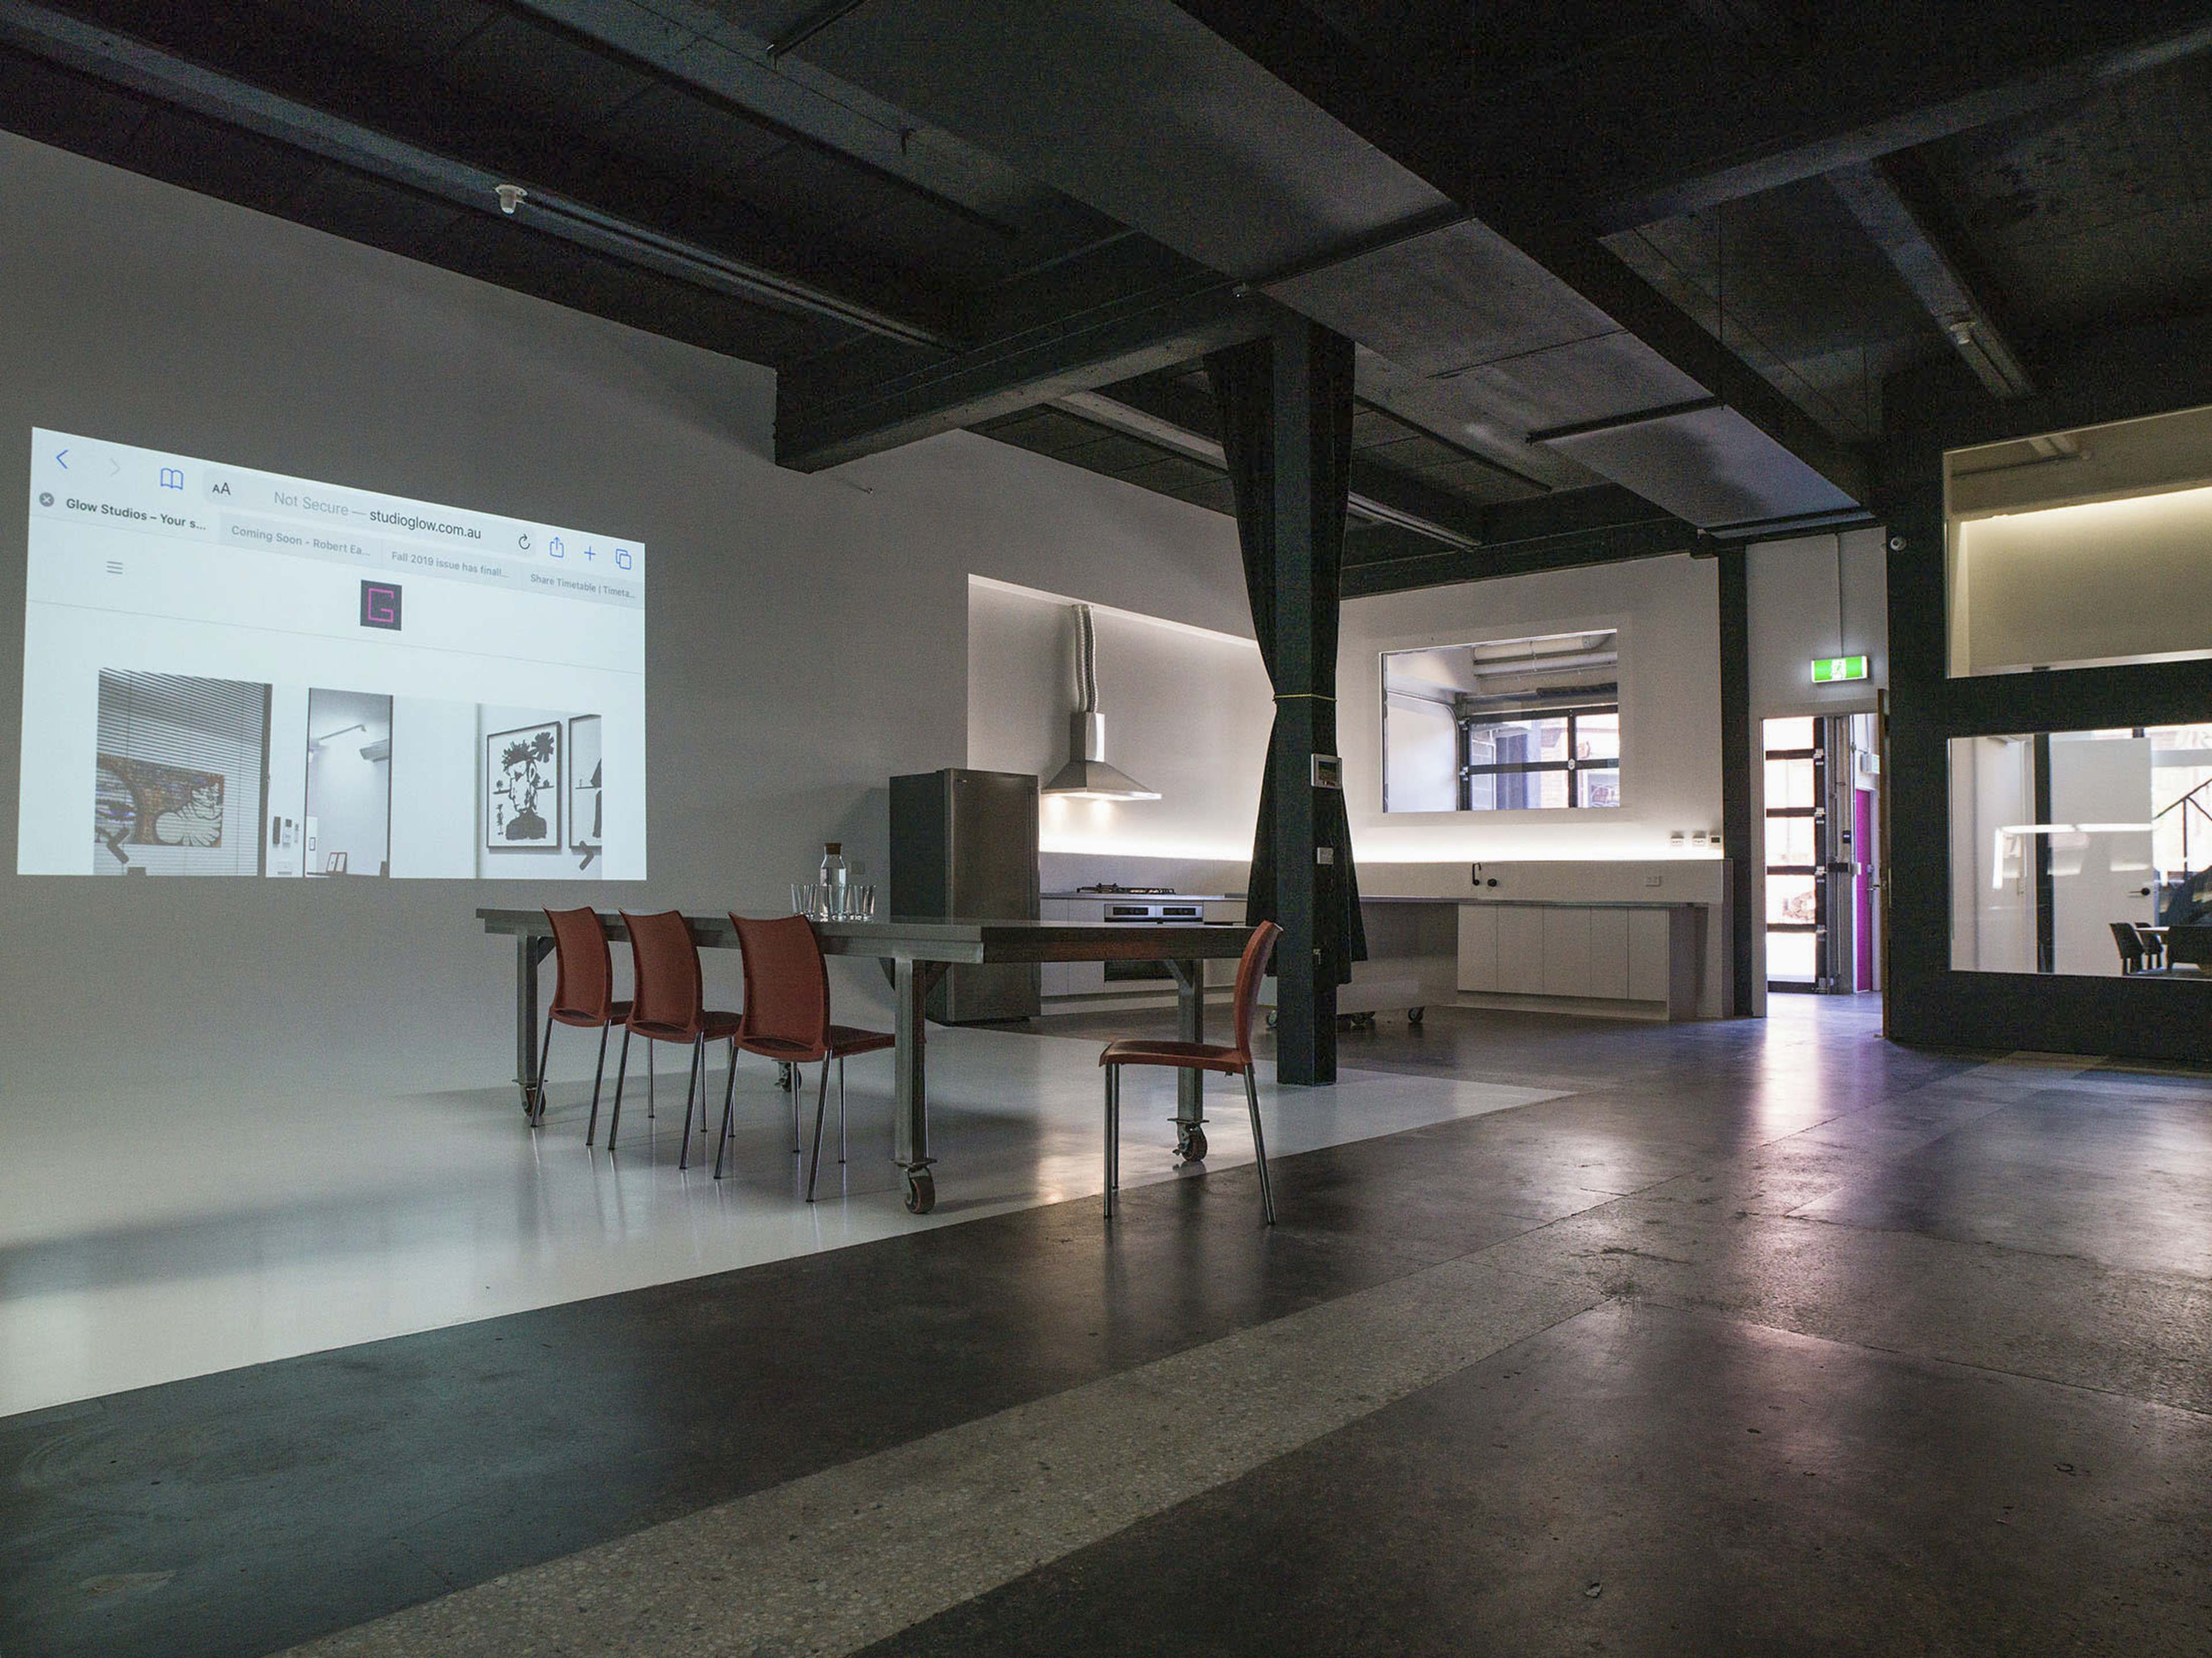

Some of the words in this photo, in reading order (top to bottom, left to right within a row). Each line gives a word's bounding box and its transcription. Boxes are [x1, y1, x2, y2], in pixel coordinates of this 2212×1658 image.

[66, 498, 97, 512] Glow
[101, 503, 147, 520] Studios
[160, 513, 186, 526] Your
[274, 491, 298, 507] Not
[302, 496, 349, 516] Secure
[369, 510, 481, 539] studioglow.com.au
[232, 525, 273, 543] Coming
[276, 532, 302, 545] Soon
[313, 539, 348, 553] Robert
[392, 551, 408, 561] Fall
[411, 554, 434, 566] 2019
[435, 557, 460, 570] issue
[462, 562, 478, 573] has
[531, 574, 555, 586] Share
[557, 578, 597, 593] Timetable
[368, 587, 394, 623] G
